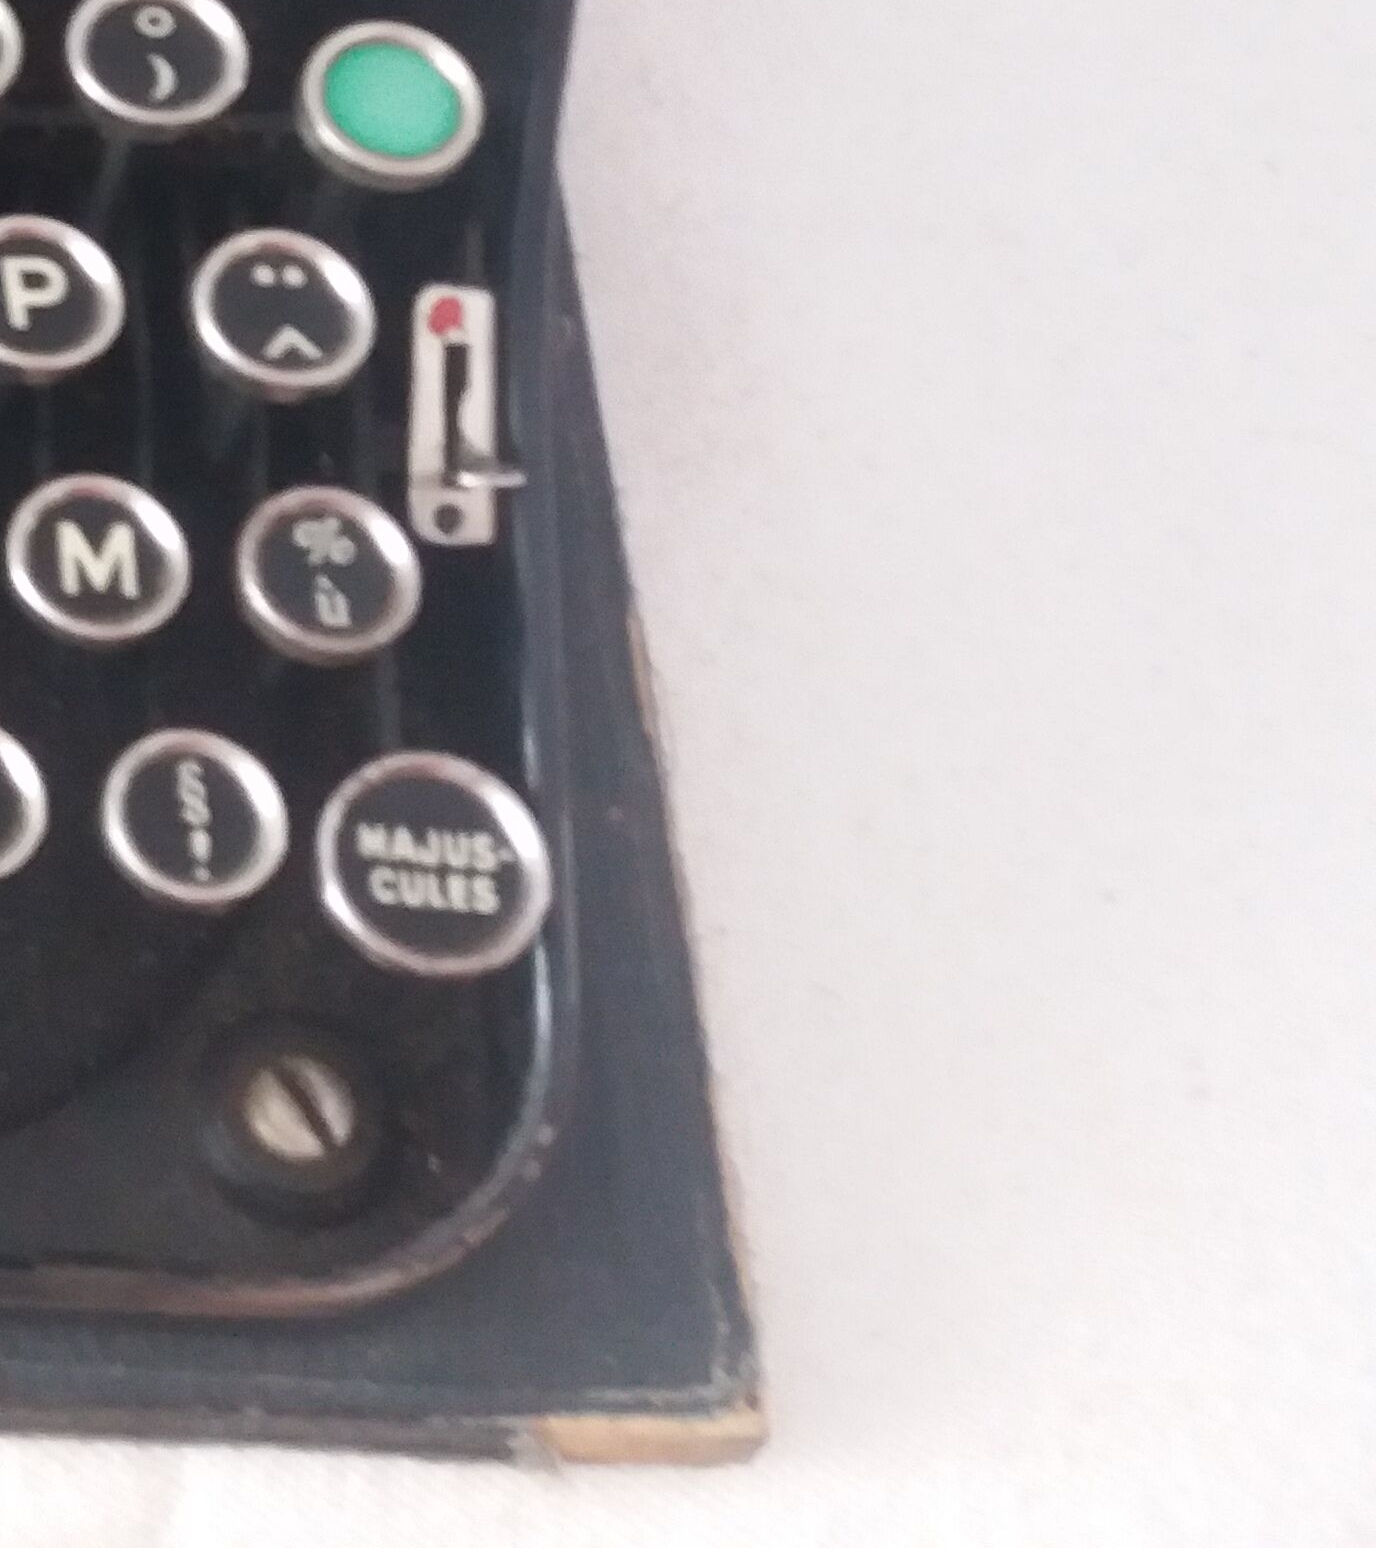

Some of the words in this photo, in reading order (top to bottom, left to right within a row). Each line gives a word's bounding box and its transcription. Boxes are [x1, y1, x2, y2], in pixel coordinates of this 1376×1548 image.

[0, 257, 67, 329] P
[58, 522, 137, 597] M
[370, 866, 499, 914] CULES
